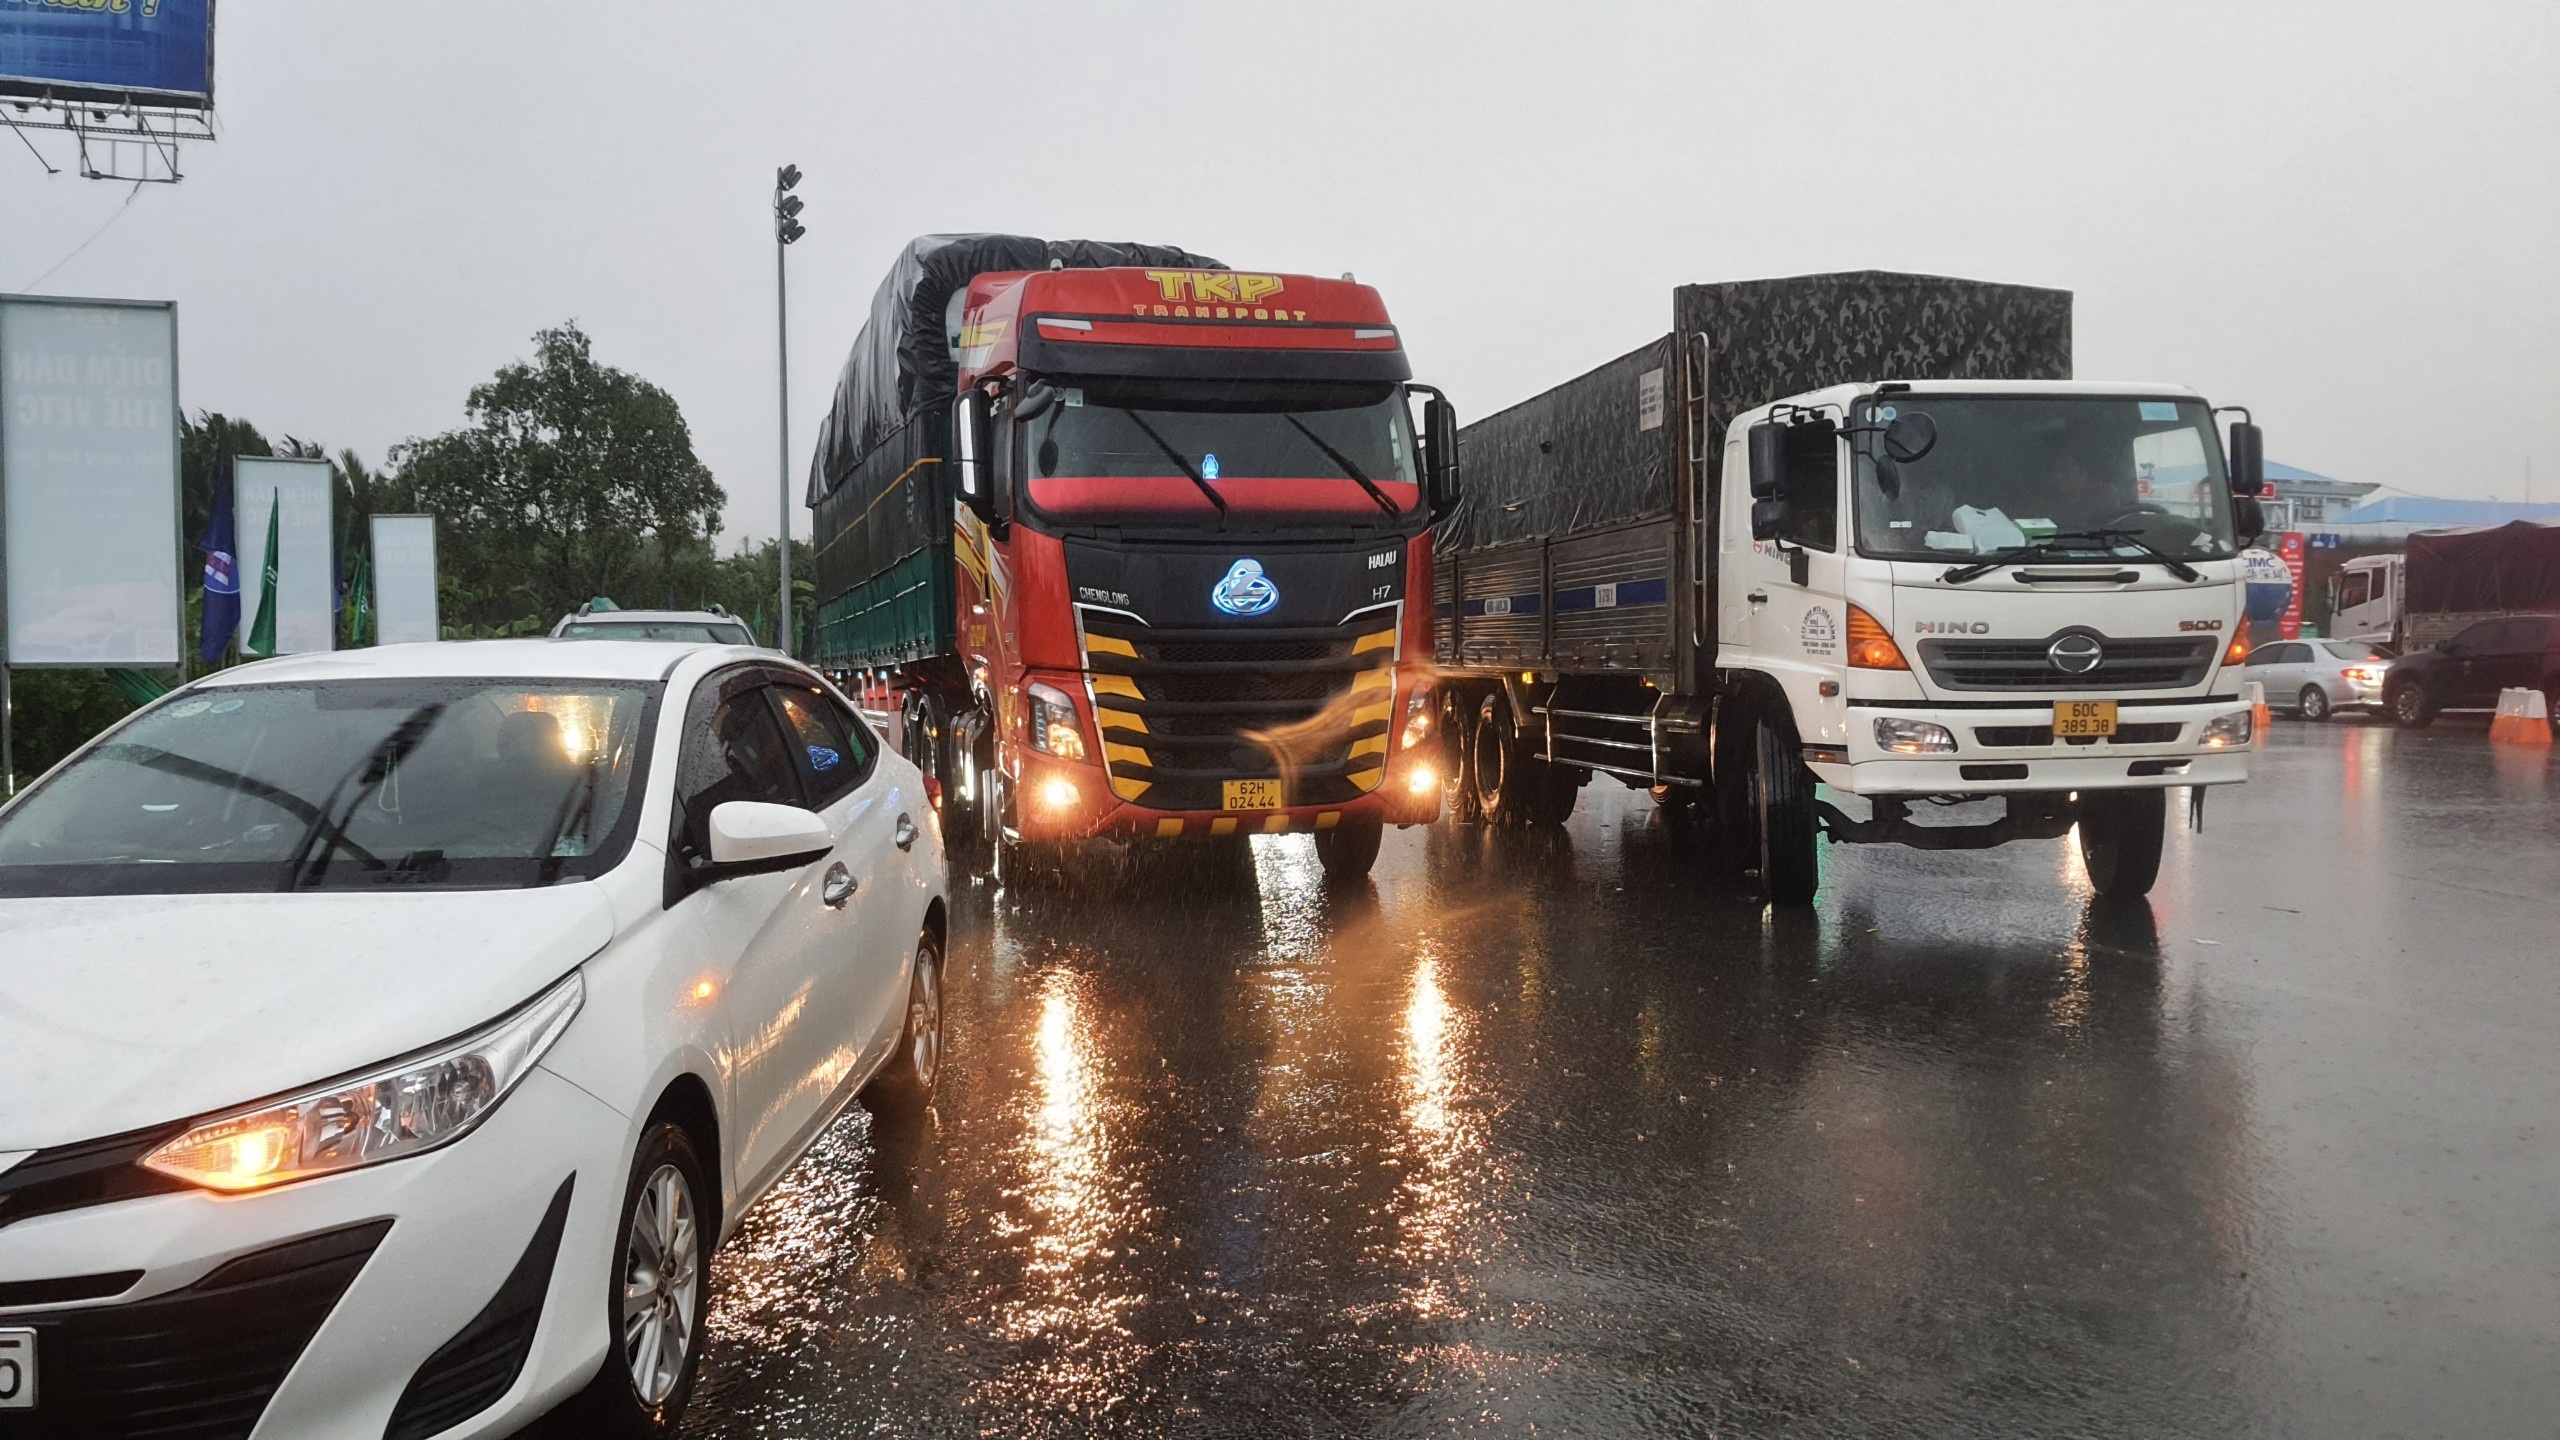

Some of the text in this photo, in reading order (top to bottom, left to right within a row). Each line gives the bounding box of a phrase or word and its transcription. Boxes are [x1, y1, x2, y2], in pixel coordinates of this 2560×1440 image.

[1145, 270, 1284, 304] TKP
[1133, 304, 1306, 321] TRANSPORT
[1368, 550, 1397, 570] HALAU
[1079, 586, 1130, 605] CHENGLONG
[1372, 584, 1392, 601] H7
[1915, 621, 1989, 634] HINO
[2179, 619, 2222, 631] 500
[2072, 703, 2099, 717] 60C
[2061, 719, 2109, 733] 389.38
[1240, 782, 1265, 795] 62H
[1230, 795, 1275, 809] 024.44
